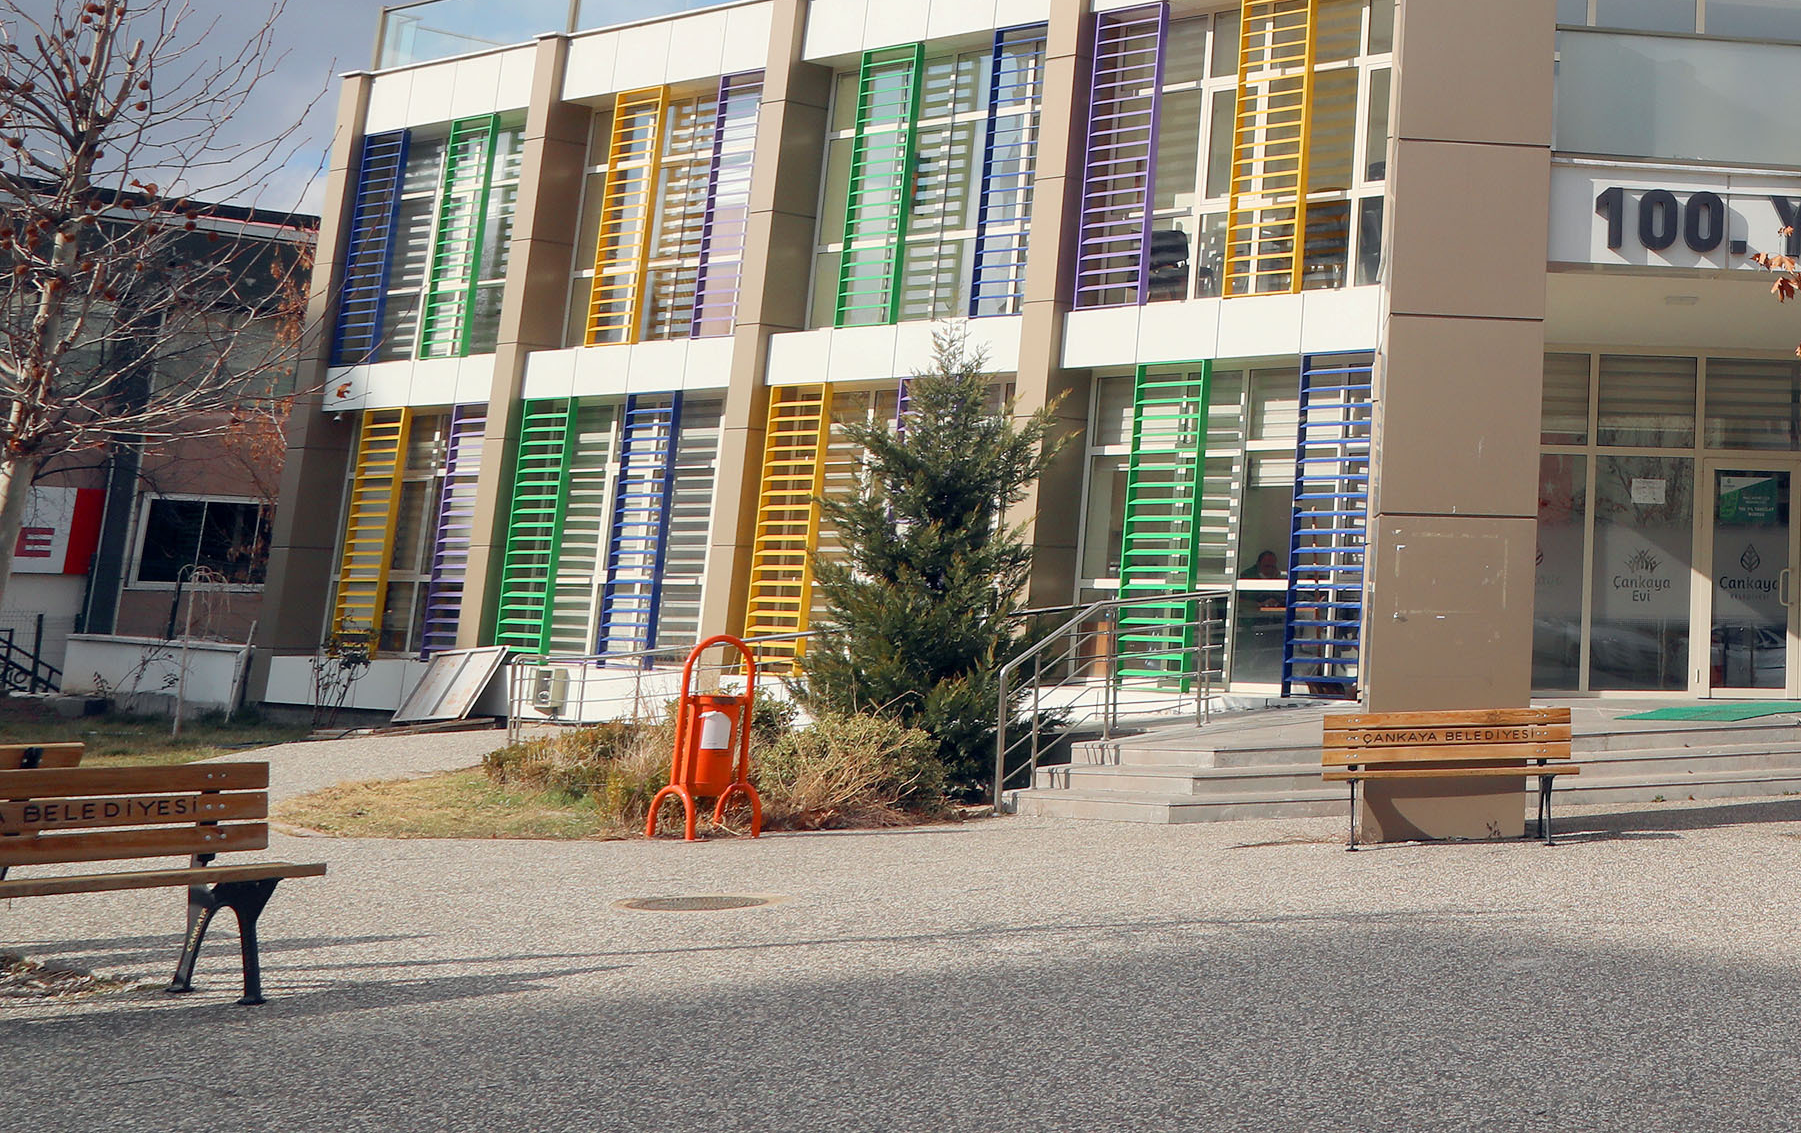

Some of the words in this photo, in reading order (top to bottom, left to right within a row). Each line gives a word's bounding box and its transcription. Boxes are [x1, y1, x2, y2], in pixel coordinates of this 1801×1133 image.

[1595, 187, 1747, 254] 100.
[1613, 575, 1672, 591] Çankaya
[1632, 590, 1652, 602] Evi
[1362, 732, 1437, 745] ÇANKAYA
[1445, 728, 1535, 741] BELEDİYESİ
[23, 796, 198, 823] BELEDİYESİ
